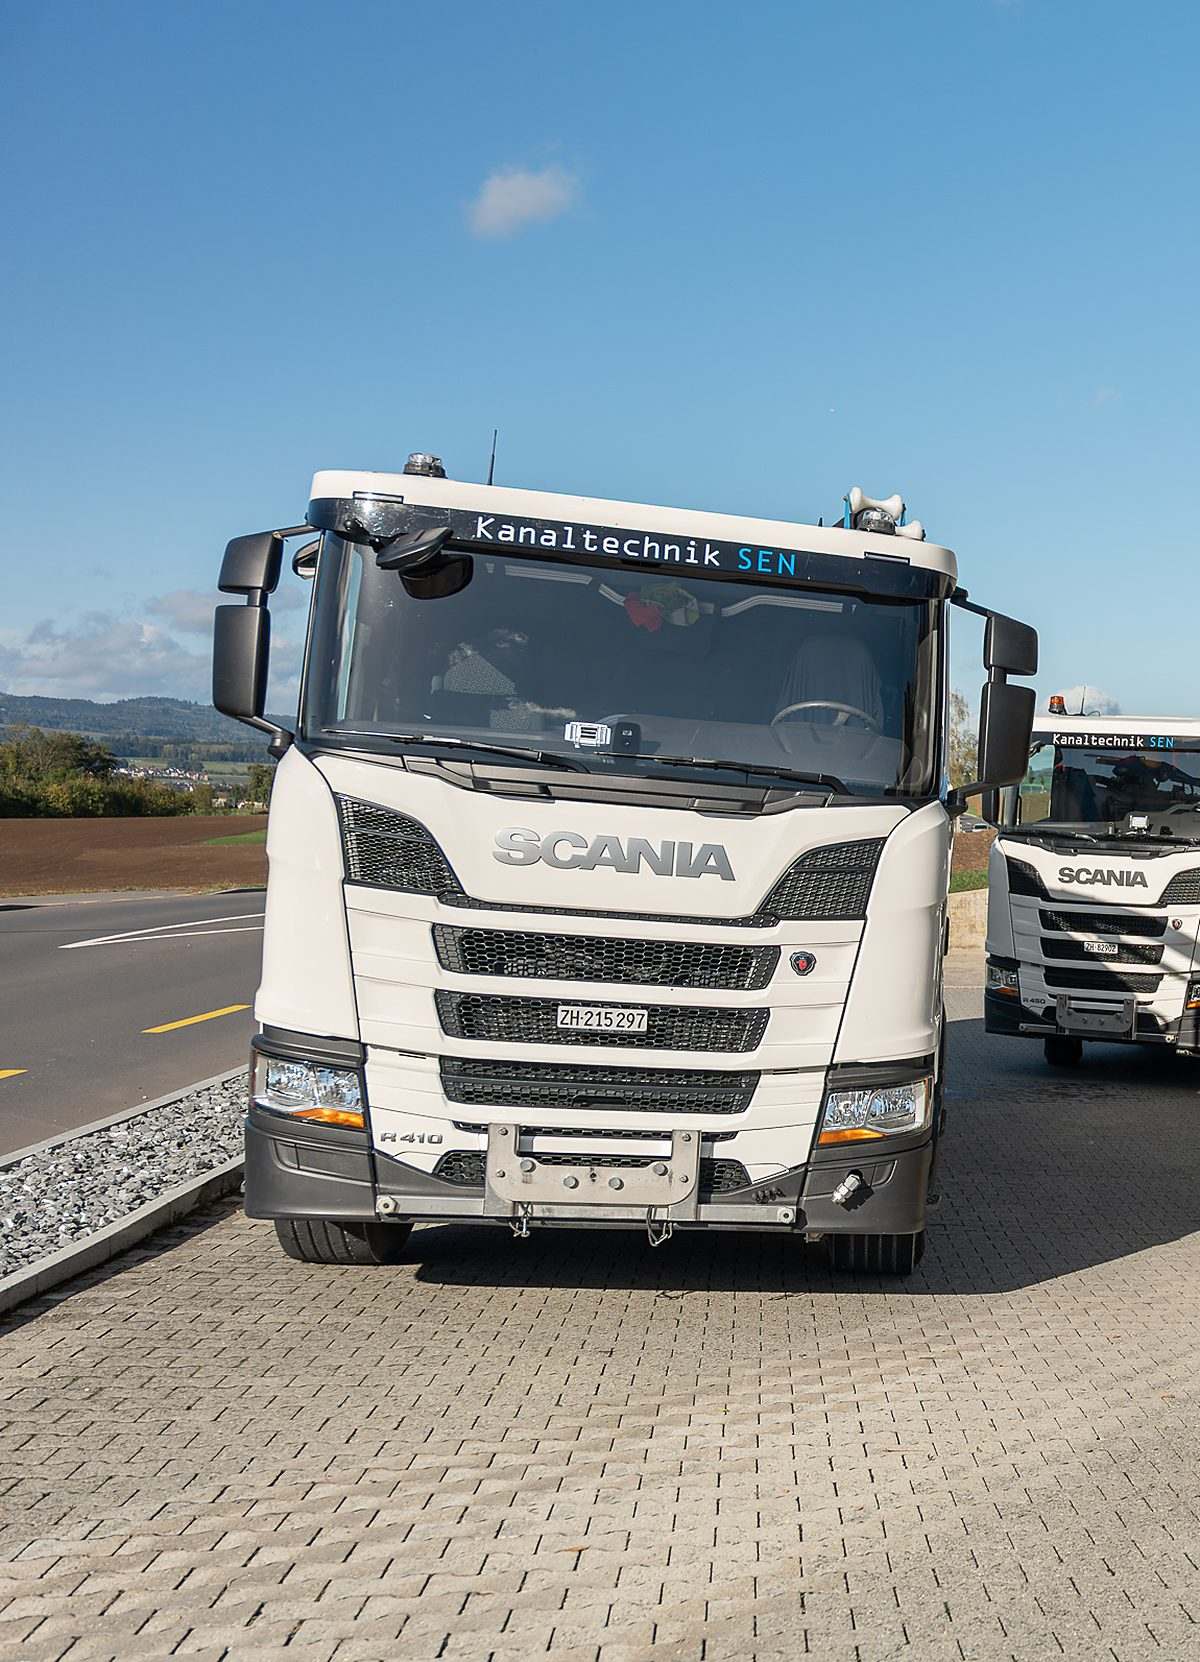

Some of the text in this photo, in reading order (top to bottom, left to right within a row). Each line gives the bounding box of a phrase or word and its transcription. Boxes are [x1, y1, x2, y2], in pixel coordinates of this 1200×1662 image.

[475, 516, 796, 576] Kanaltechnik SEN
[1052, 733, 1175, 748] Kanaltechnik SEN
[492, 827, 736, 881] SCANIA
[1057, 866, 1149, 889] SCANIA
[380, 1132, 444, 1145] R 410
